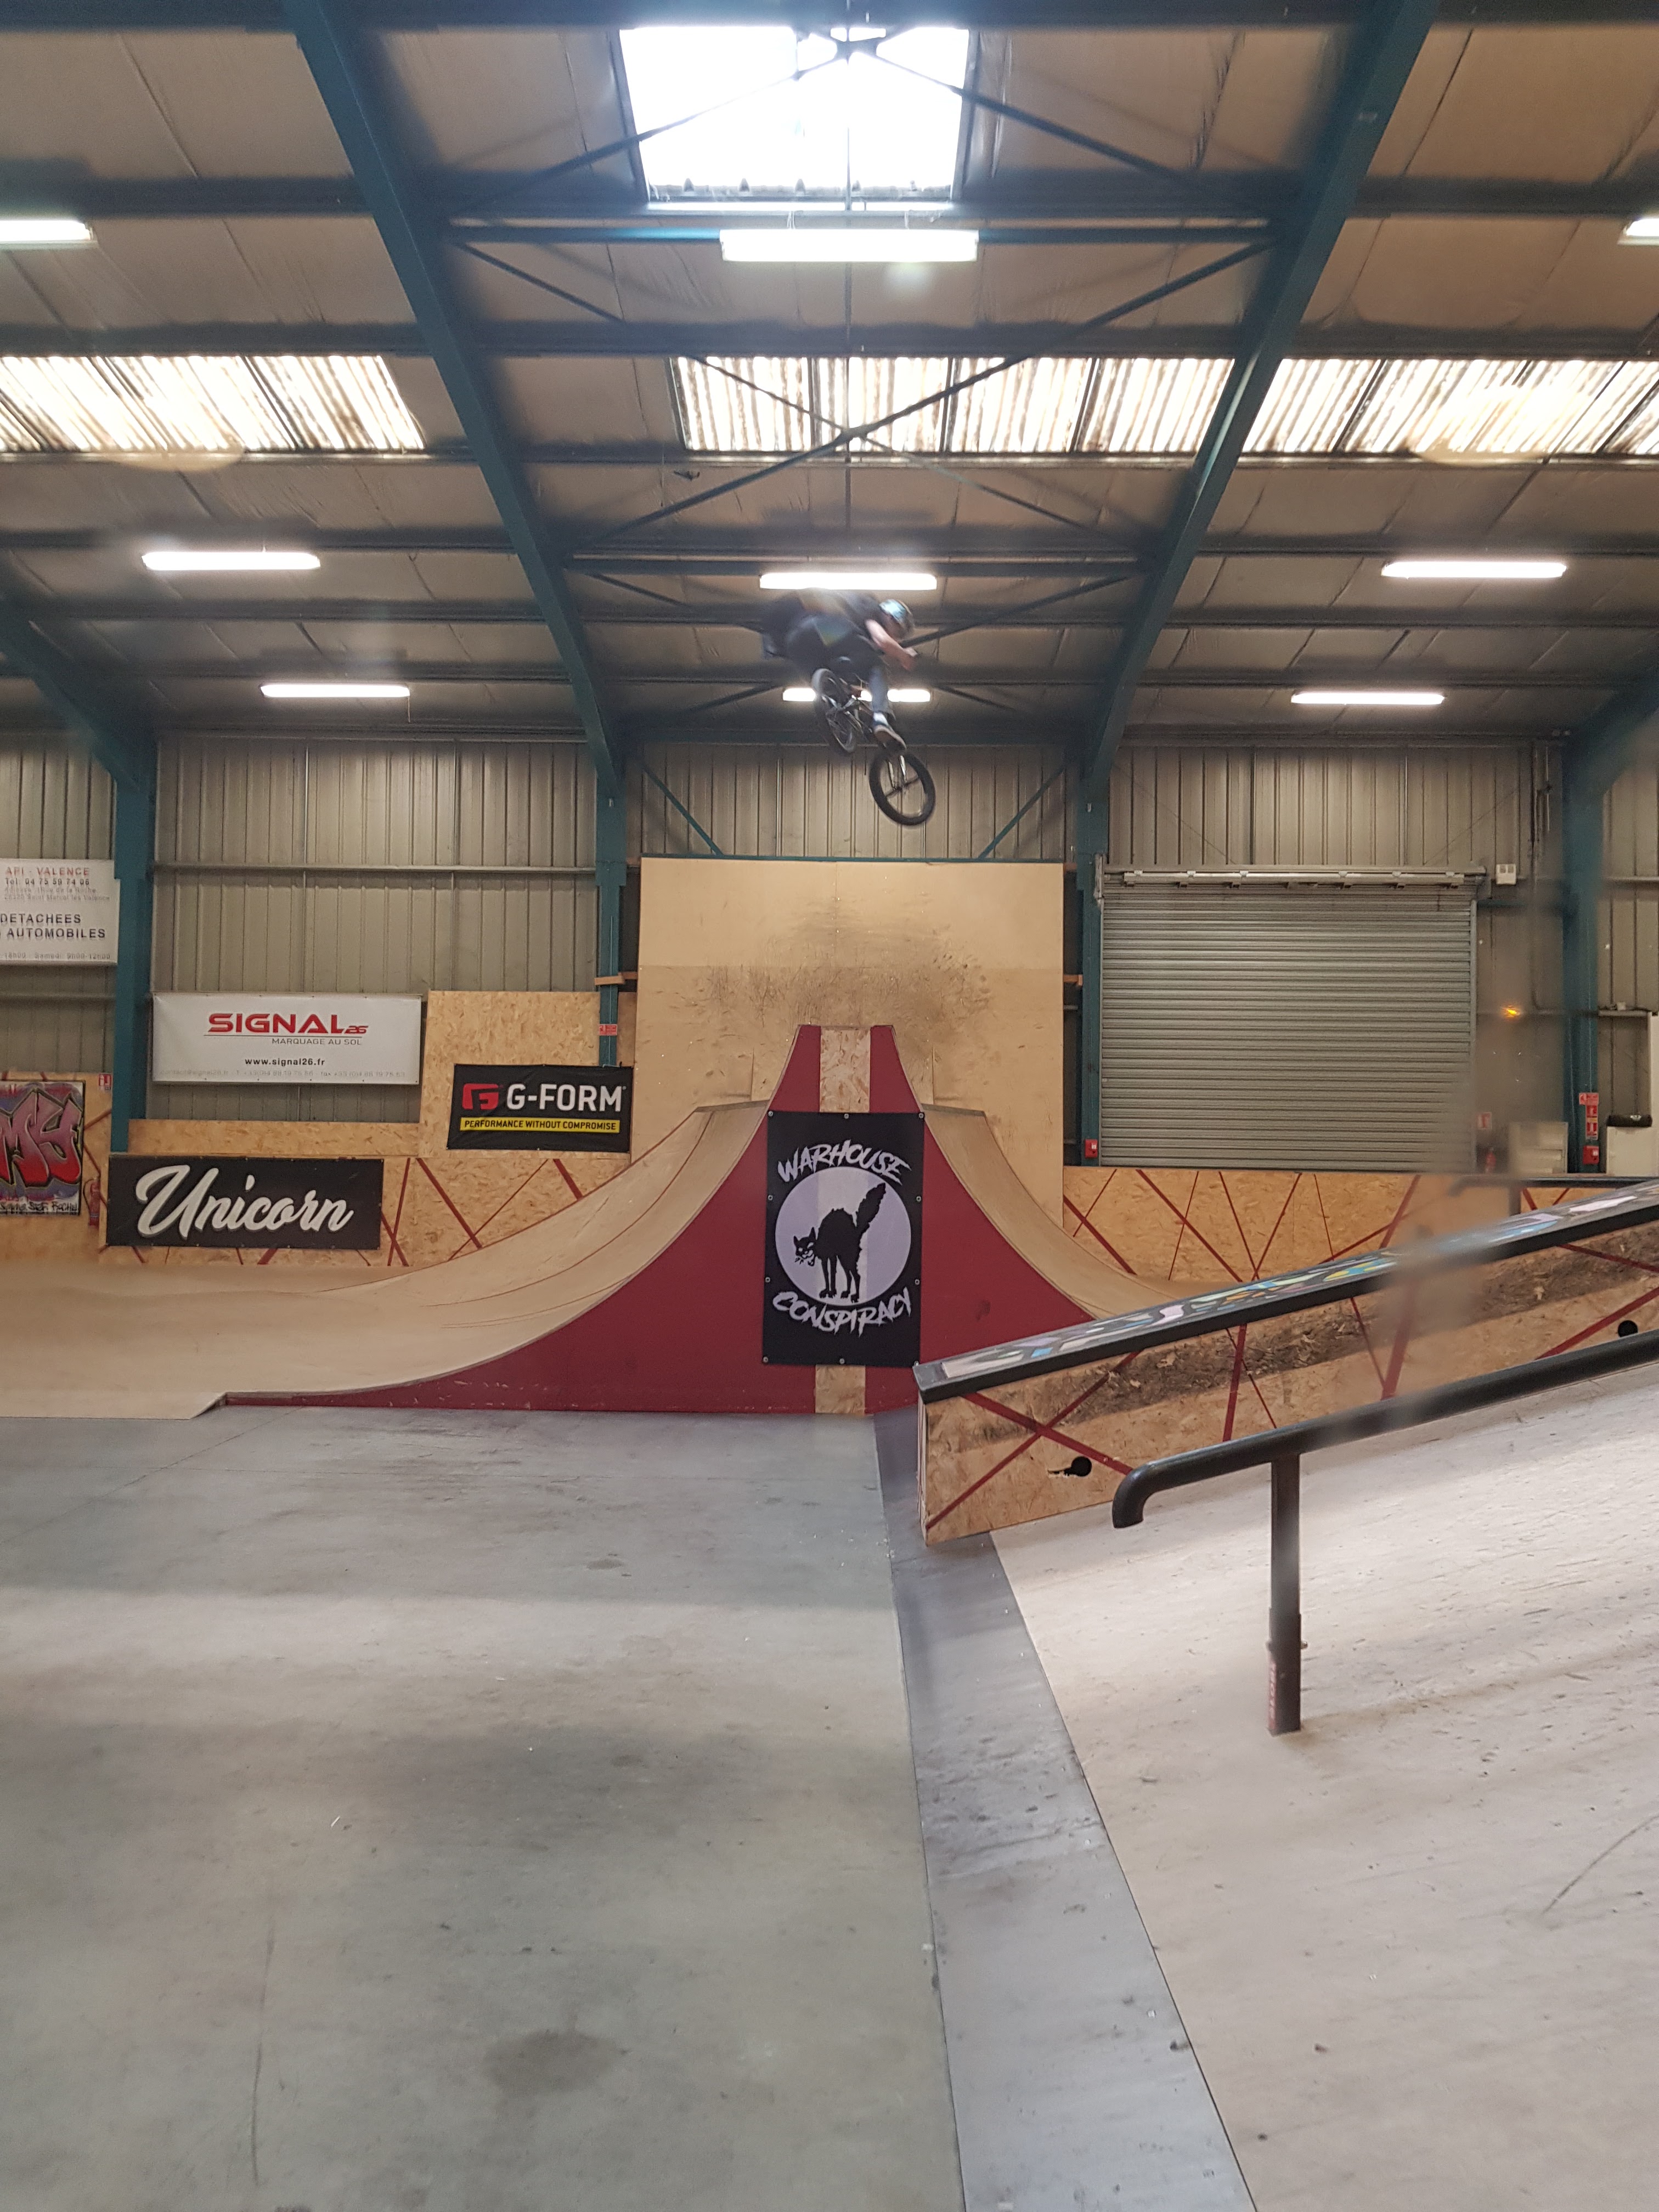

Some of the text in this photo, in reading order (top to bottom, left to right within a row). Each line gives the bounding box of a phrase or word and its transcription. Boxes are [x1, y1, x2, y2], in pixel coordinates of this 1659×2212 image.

[5, 867, 24, 876] API
[37, 867, 89, 876] VALENCE
[1, 913, 81, 923] DETACHEES
[7, 928, 105, 938] AUTOMOBILES
[245, 1058, 325, 1066] www.signal26.fr
[465, 1120, 616, 1130] PERFORMANCE WITHOUT COMPROMISE
[777, 1139, 912, 1186] WARHOUSE
[136, 1164, 354, 1240] Unicorn
[772, 1286, 911, 1338] CONSPIRACY
